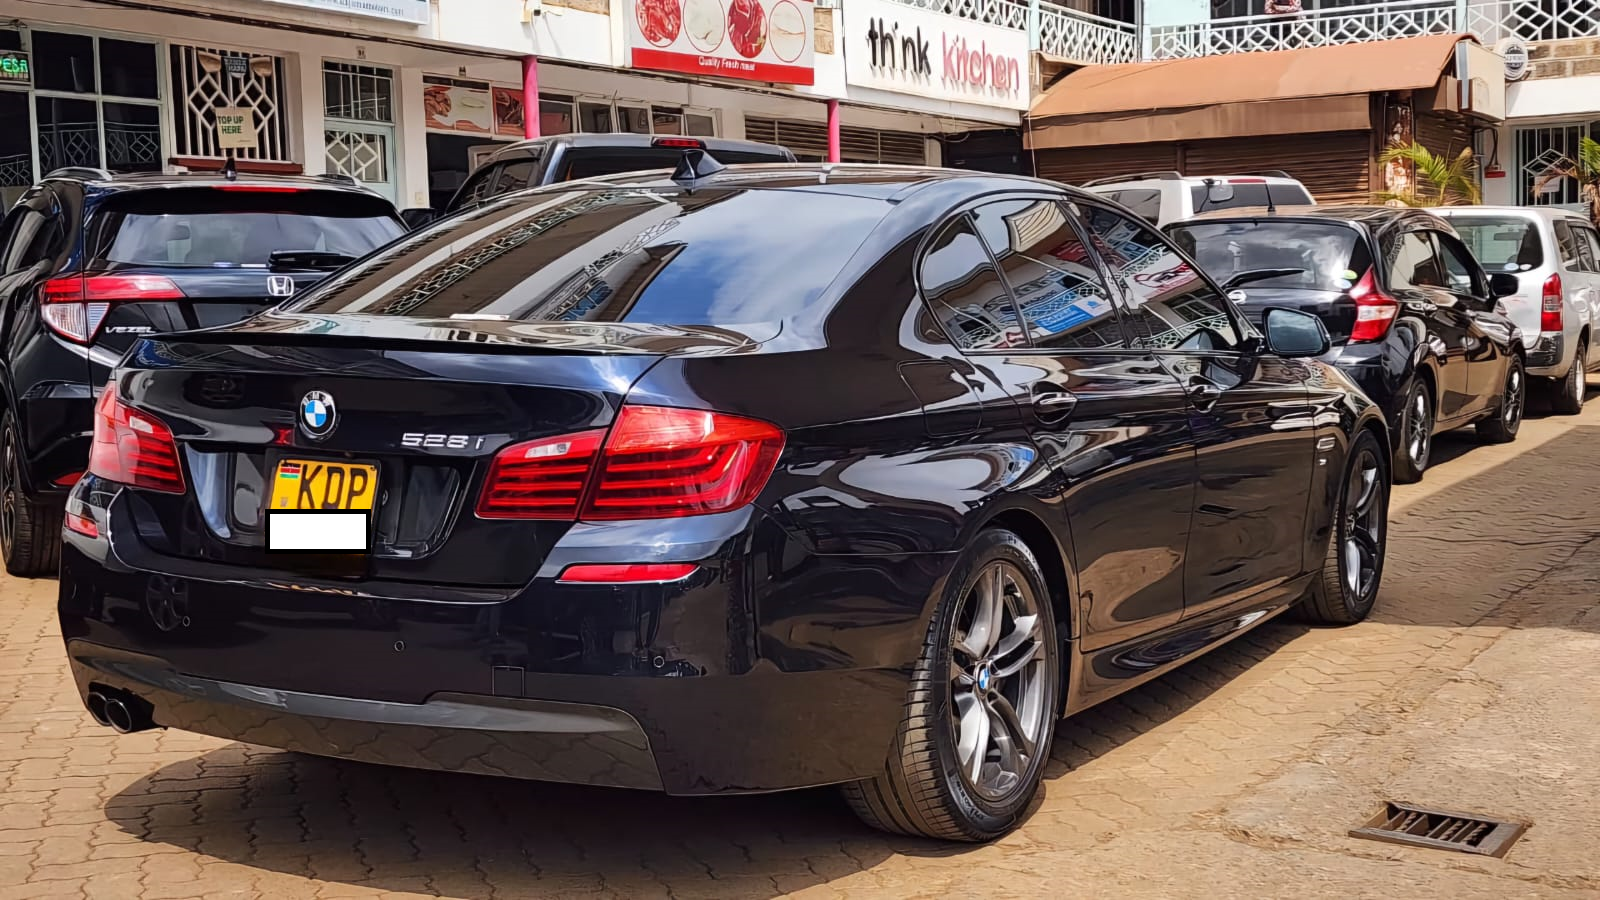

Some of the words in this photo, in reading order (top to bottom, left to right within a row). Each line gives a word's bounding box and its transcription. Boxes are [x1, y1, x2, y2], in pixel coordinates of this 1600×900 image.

[0, 58, 29, 73] ESA
[699, 56, 720, 70] Quality
[722, 58, 739, 69] Fresh
[942, 31, 1019, 91] kitchen
[217, 115, 232, 124] TOP
[221, 125, 242, 134] HERE
